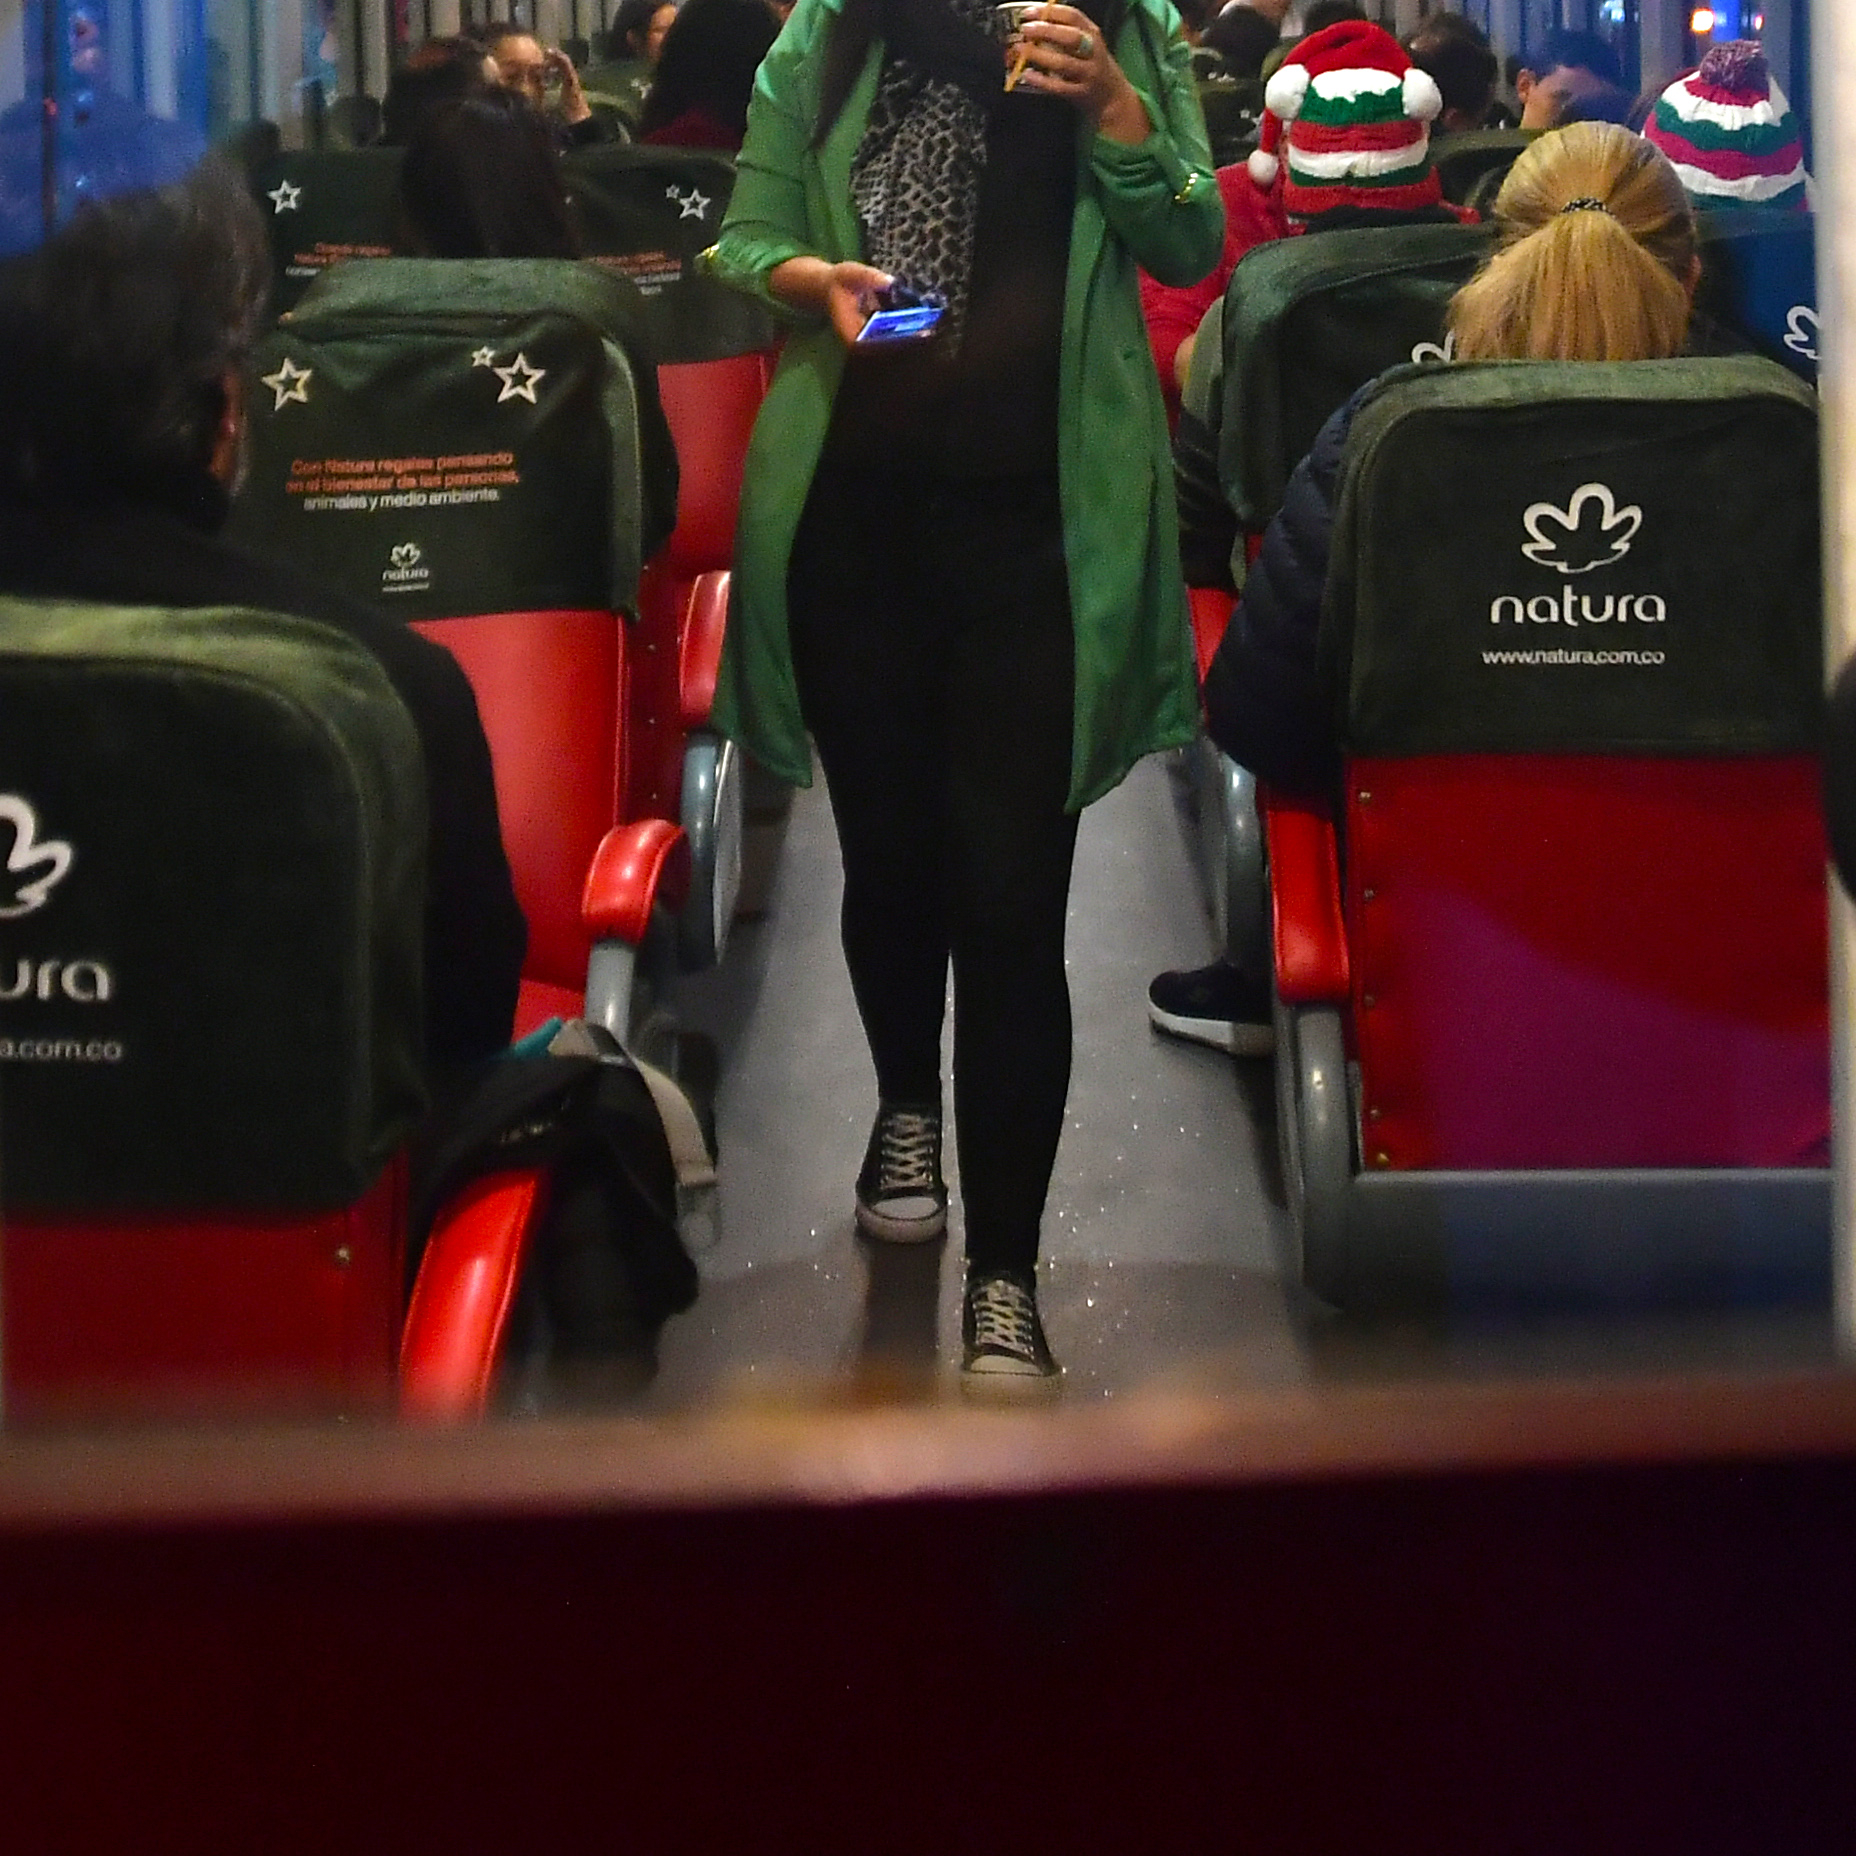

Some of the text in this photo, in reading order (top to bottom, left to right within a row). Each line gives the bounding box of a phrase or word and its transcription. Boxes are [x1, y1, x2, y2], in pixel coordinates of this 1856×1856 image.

[304, 493, 367, 512] animales
[367, 495, 379, 512] y
[380, 490, 428, 508] medio
[1490, 584, 1666, 627] natura
[1482, 648, 1666, 666] www.natura.com.co
